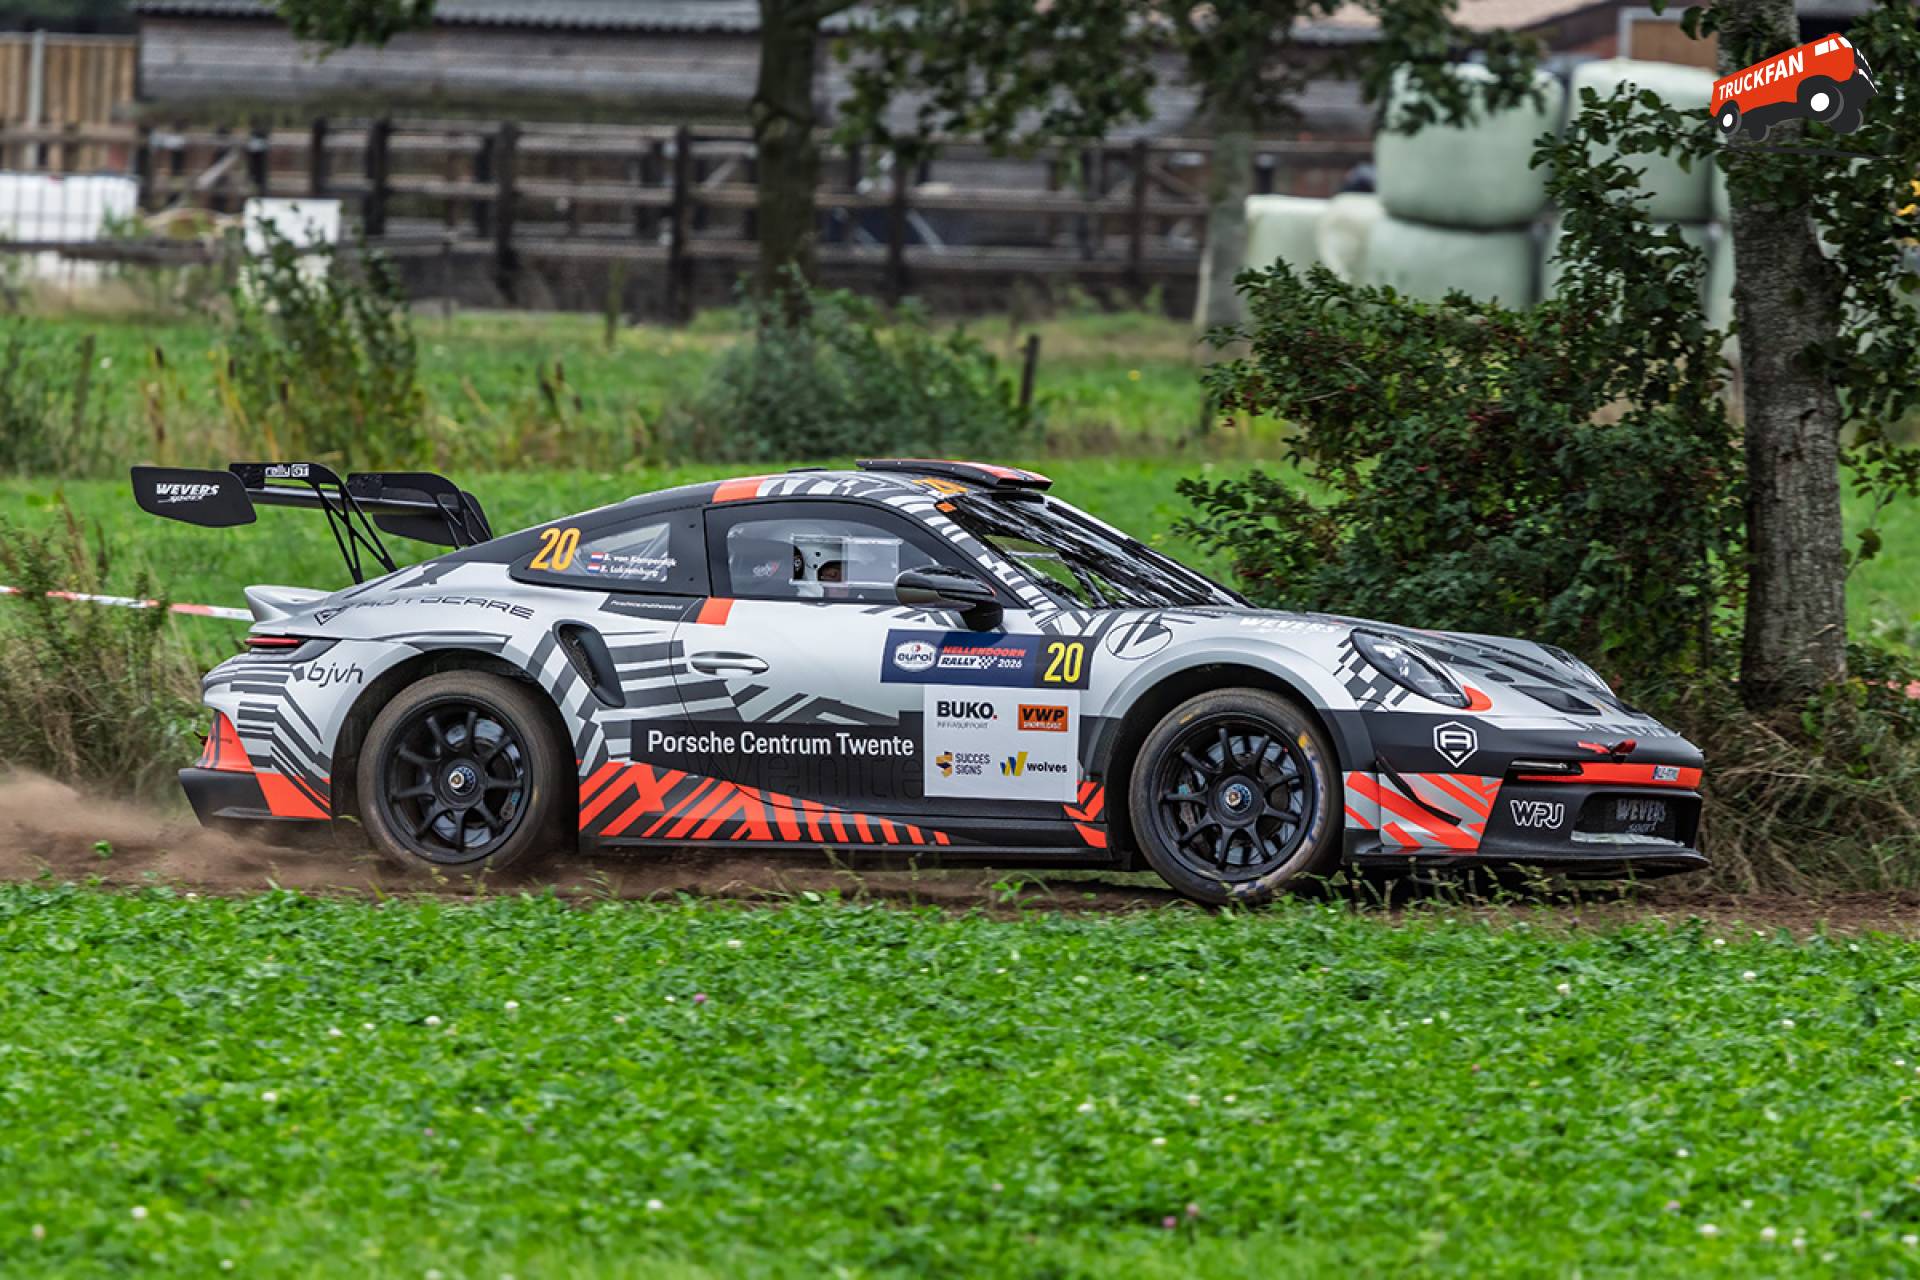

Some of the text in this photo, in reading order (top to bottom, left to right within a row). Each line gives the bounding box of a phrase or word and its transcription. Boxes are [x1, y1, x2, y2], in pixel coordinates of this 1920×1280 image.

[156, 483, 220, 496] WEVERS
[529, 528, 581, 571] 20
[943, 645, 1026, 657] HELLENDOORN
[940, 656, 977, 667] RALLY
[1043, 642, 1084, 683] 20
[307, 661, 364, 688] bjvh
[1022, 708, 1065, 722] VWP
[647, 730, 914, 756] Porsche Centrum Twente
[954, 752, 991, 765] SUCCES
[954, 764, 983, 776] SIGNS
[1027, 761, 1068, 774] wolves
